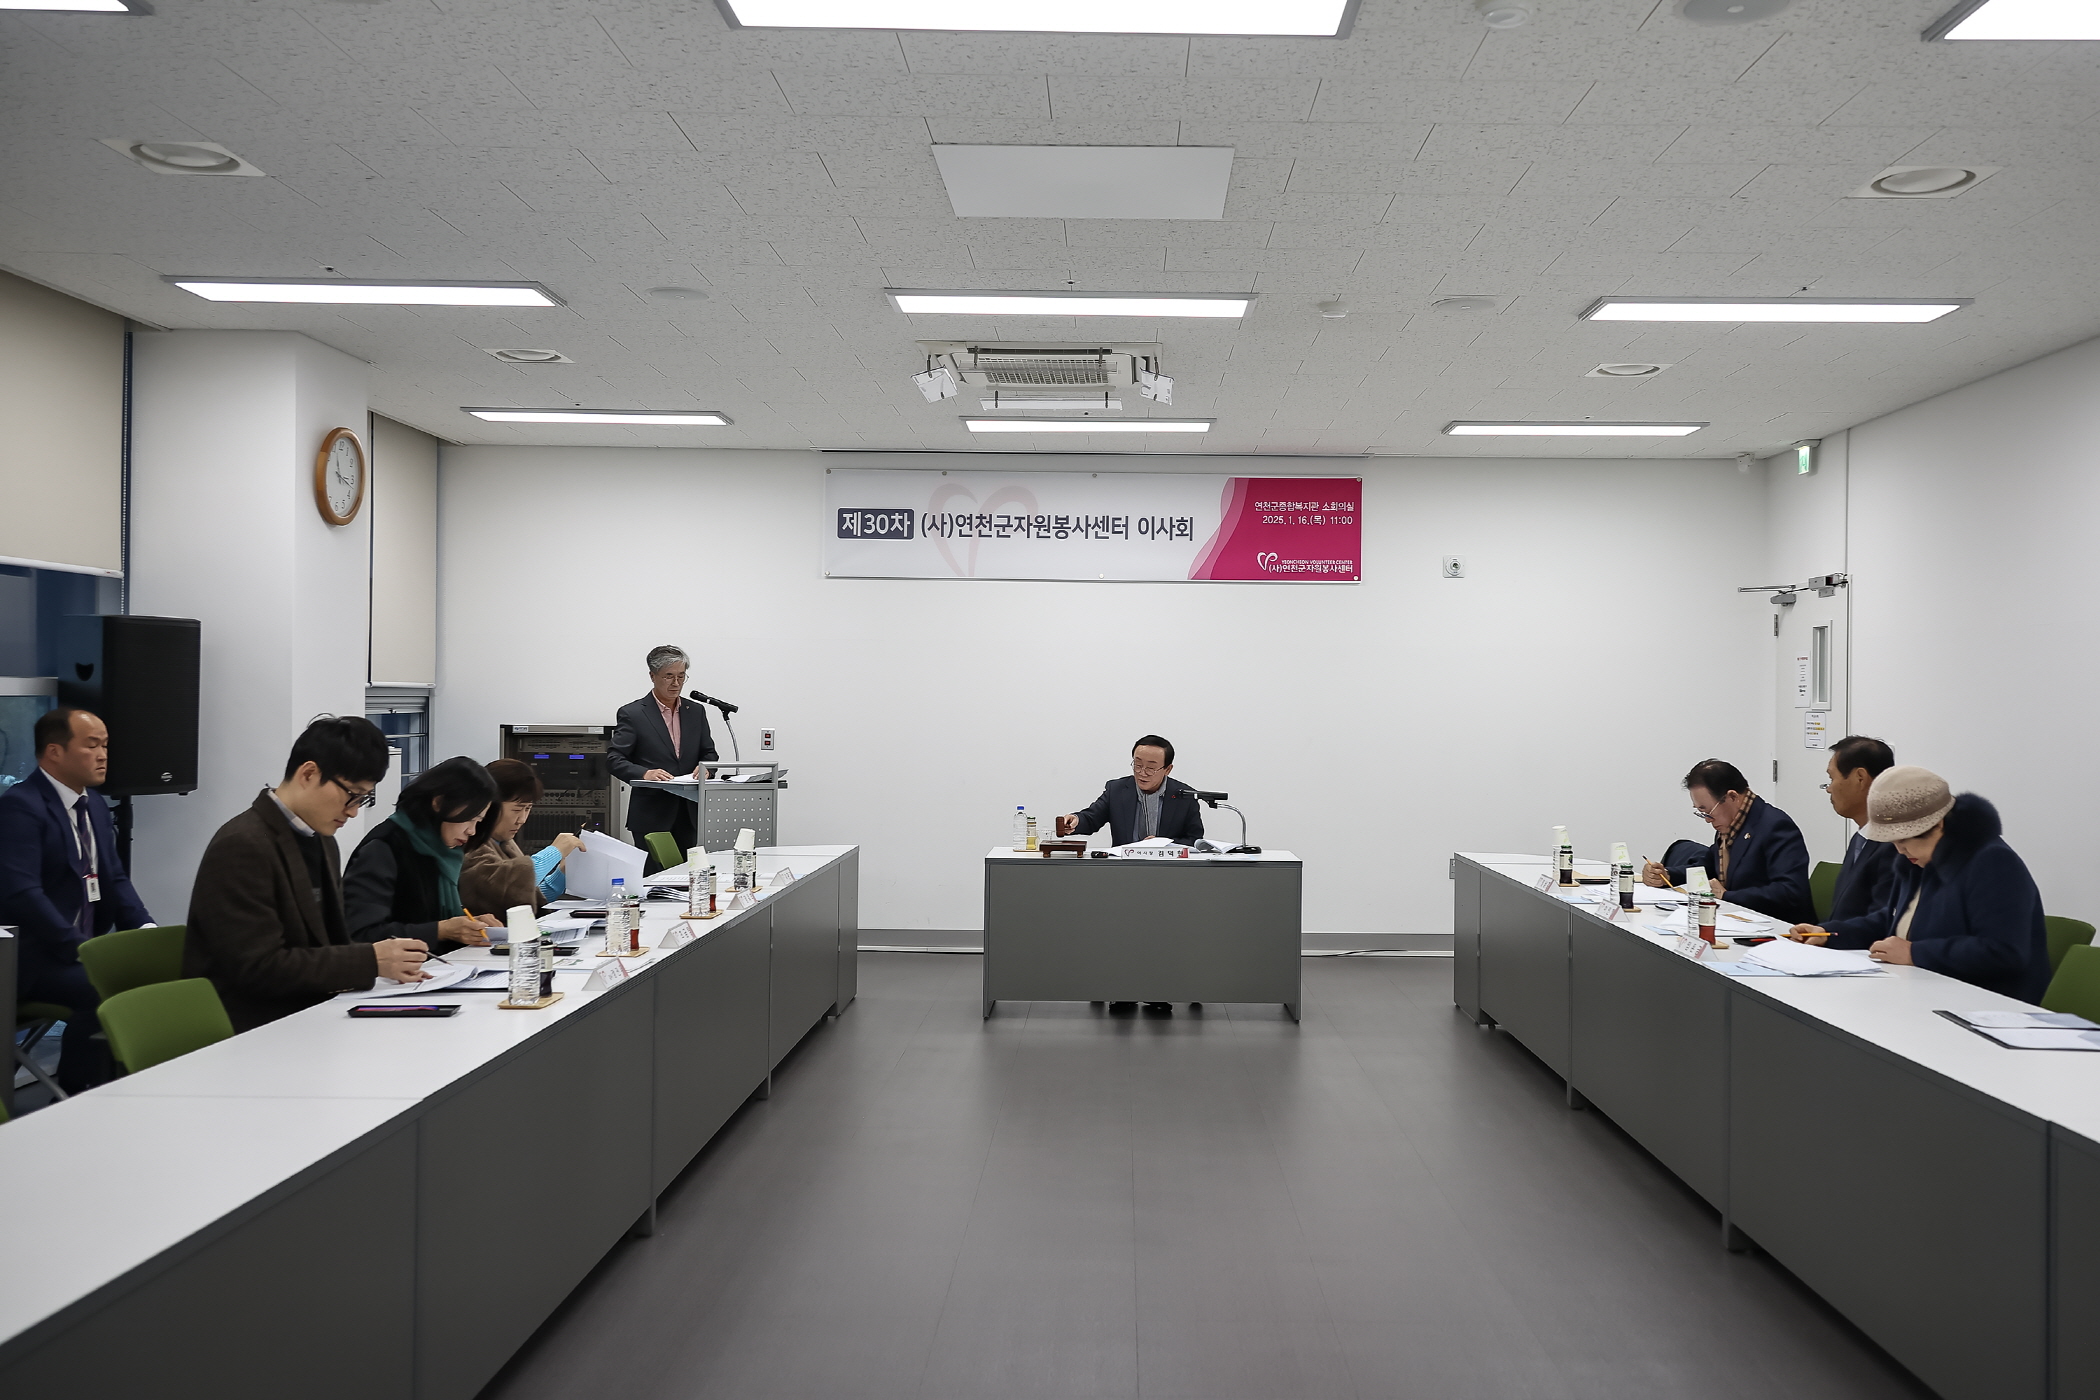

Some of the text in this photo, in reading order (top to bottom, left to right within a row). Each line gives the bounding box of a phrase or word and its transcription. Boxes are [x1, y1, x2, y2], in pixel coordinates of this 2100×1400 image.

[1321, 501, 1355, 512] 소회의실
[841, 511, 1194, 541] 제30차 (사)연천군자원봉사센터 이사회
[1330, 516, 1353, 525] 11:00
